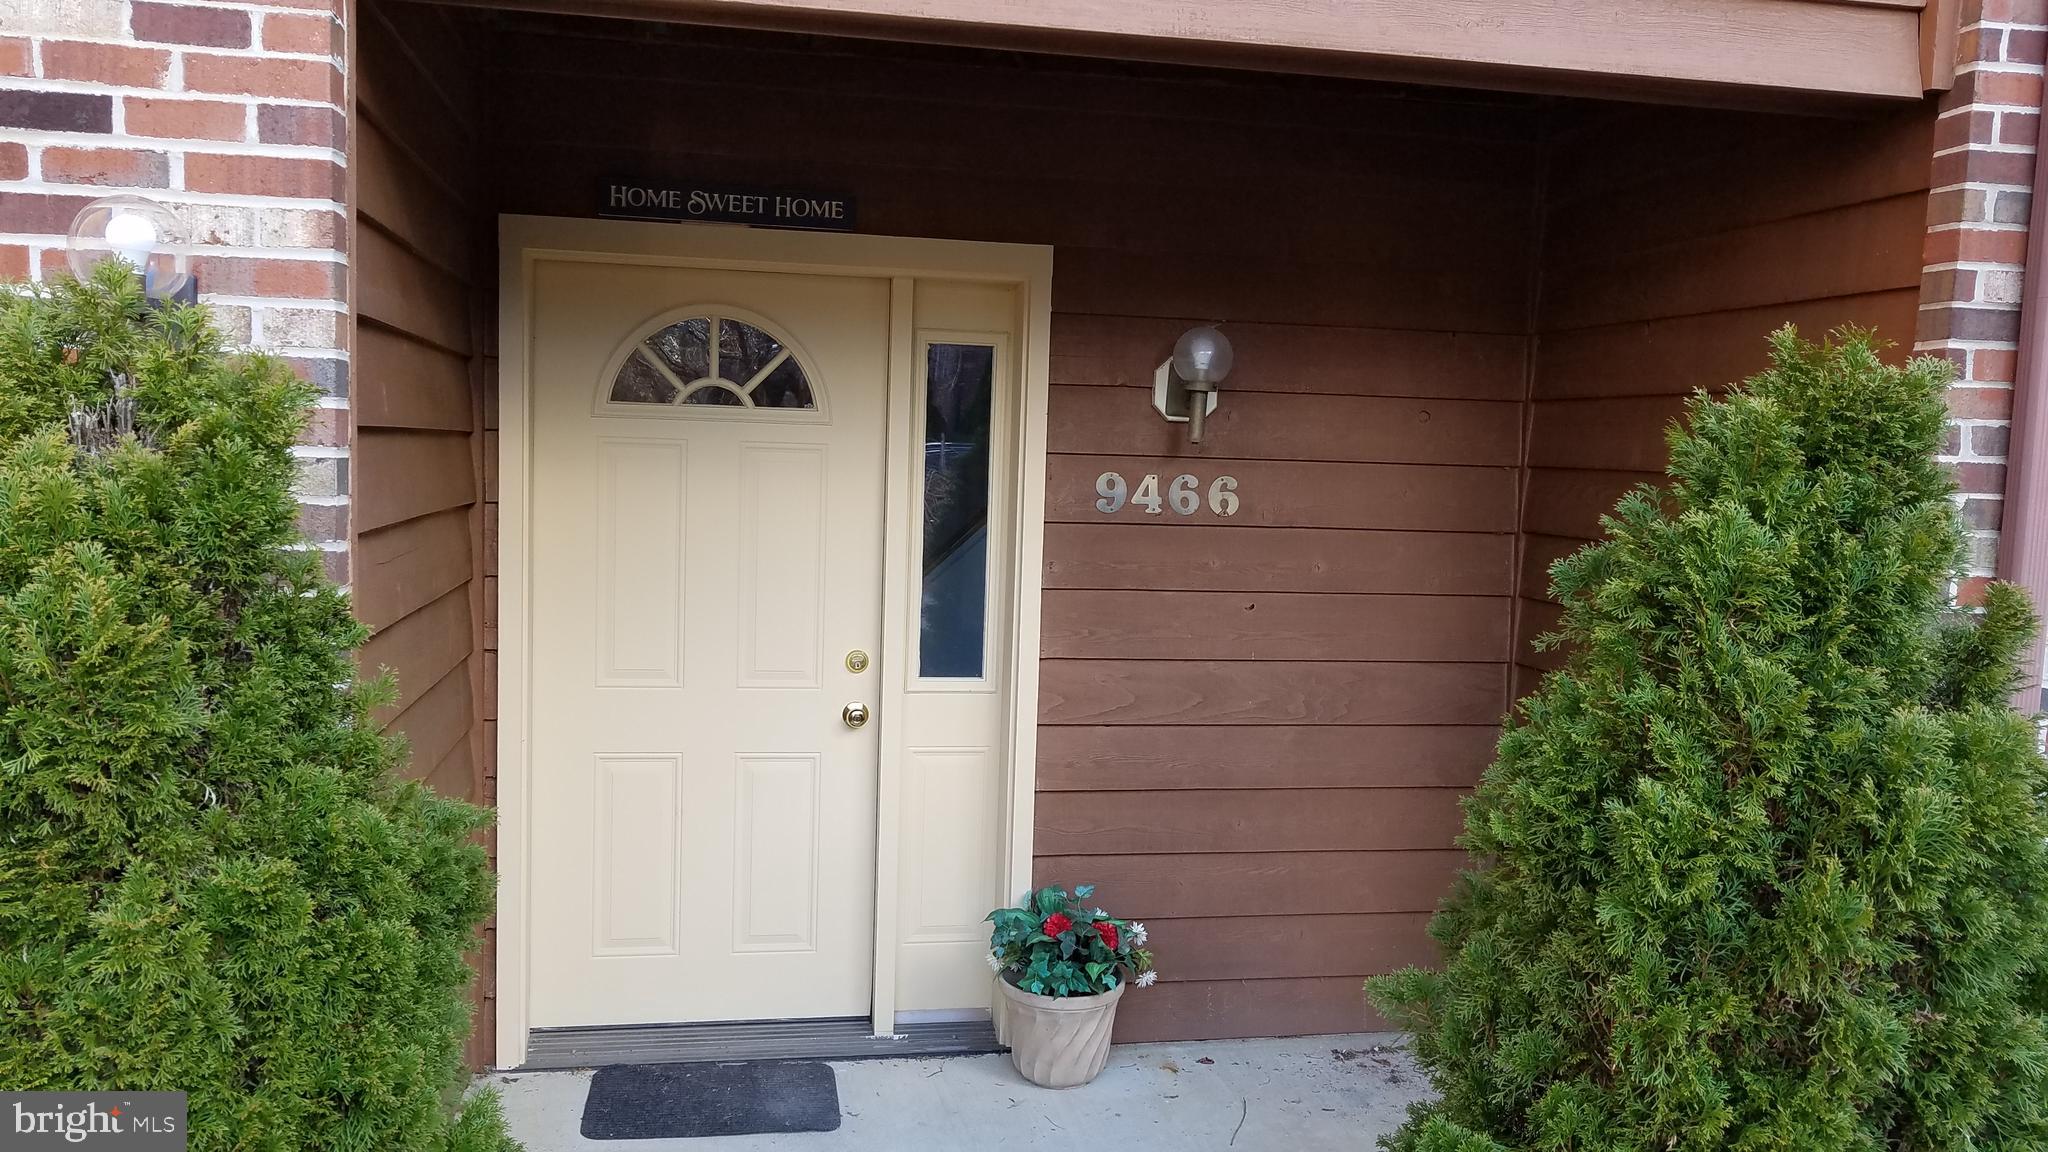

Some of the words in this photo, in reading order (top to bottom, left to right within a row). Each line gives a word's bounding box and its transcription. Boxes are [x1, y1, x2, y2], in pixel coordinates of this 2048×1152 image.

[610, 185, 681, 209] HOME
[687, 190, 768, 215] SWEET
[775, 196, 844, 219] HOME
[1095, 471, 1240, 517] 9466
